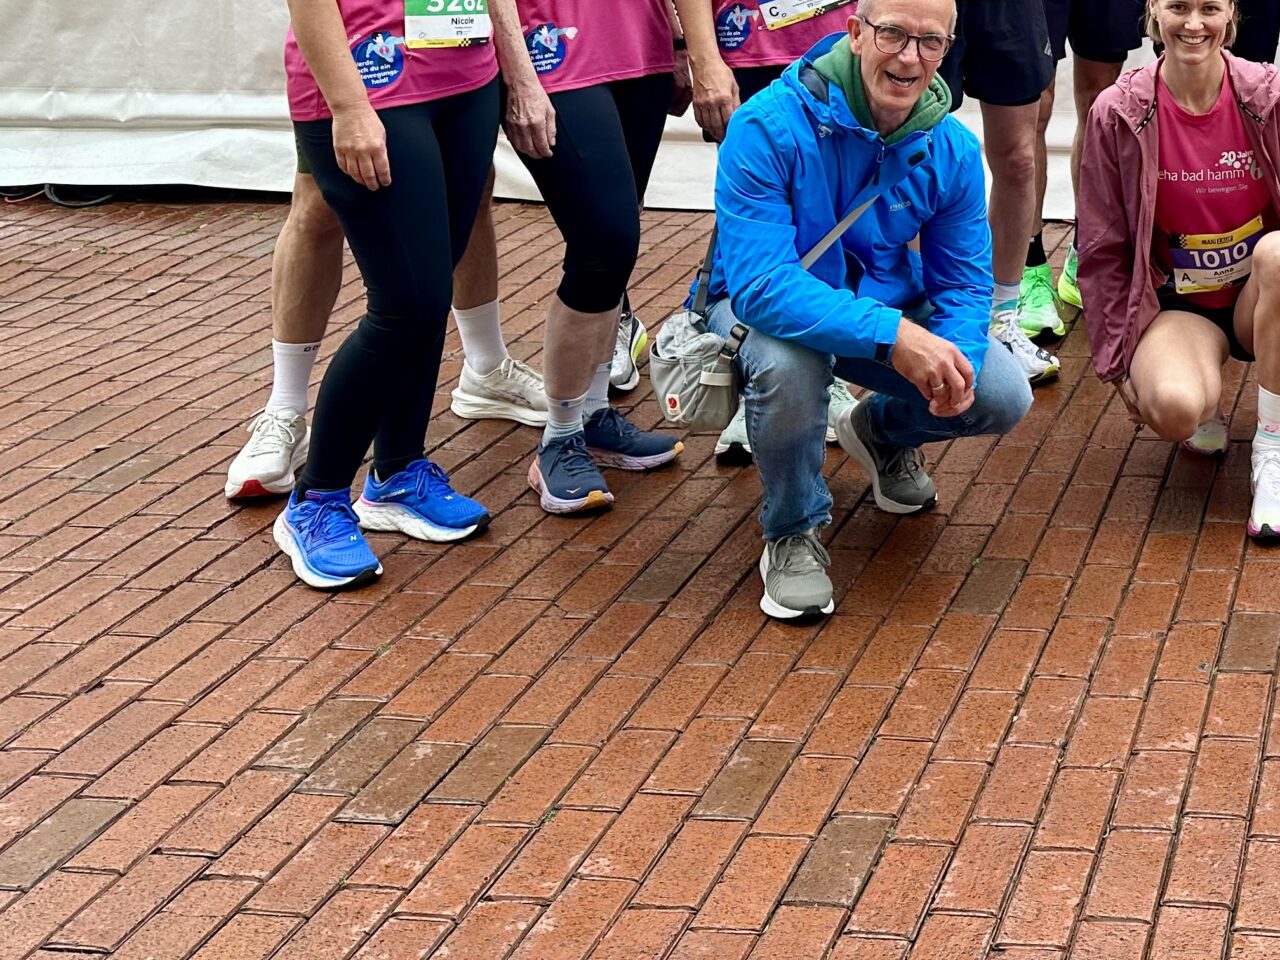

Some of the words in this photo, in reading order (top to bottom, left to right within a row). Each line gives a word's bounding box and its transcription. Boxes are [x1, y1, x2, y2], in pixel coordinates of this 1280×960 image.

[769, 6, 780, 17] C
[451, 17, 475, 25] Nicole
[360, 69, 399, 80] ewegungs-
[1219, 151, 1236, 164] 20
[1158, 169, 1178, 181] eha
[1181, 169, 1204, 182] bad
[1207, 169, 1244, 181] hamm
[1190, 243, 1248, 268] 1010
[1213, 267, 1234, 276] Anna
[1182, 273, 1191, 282] A
